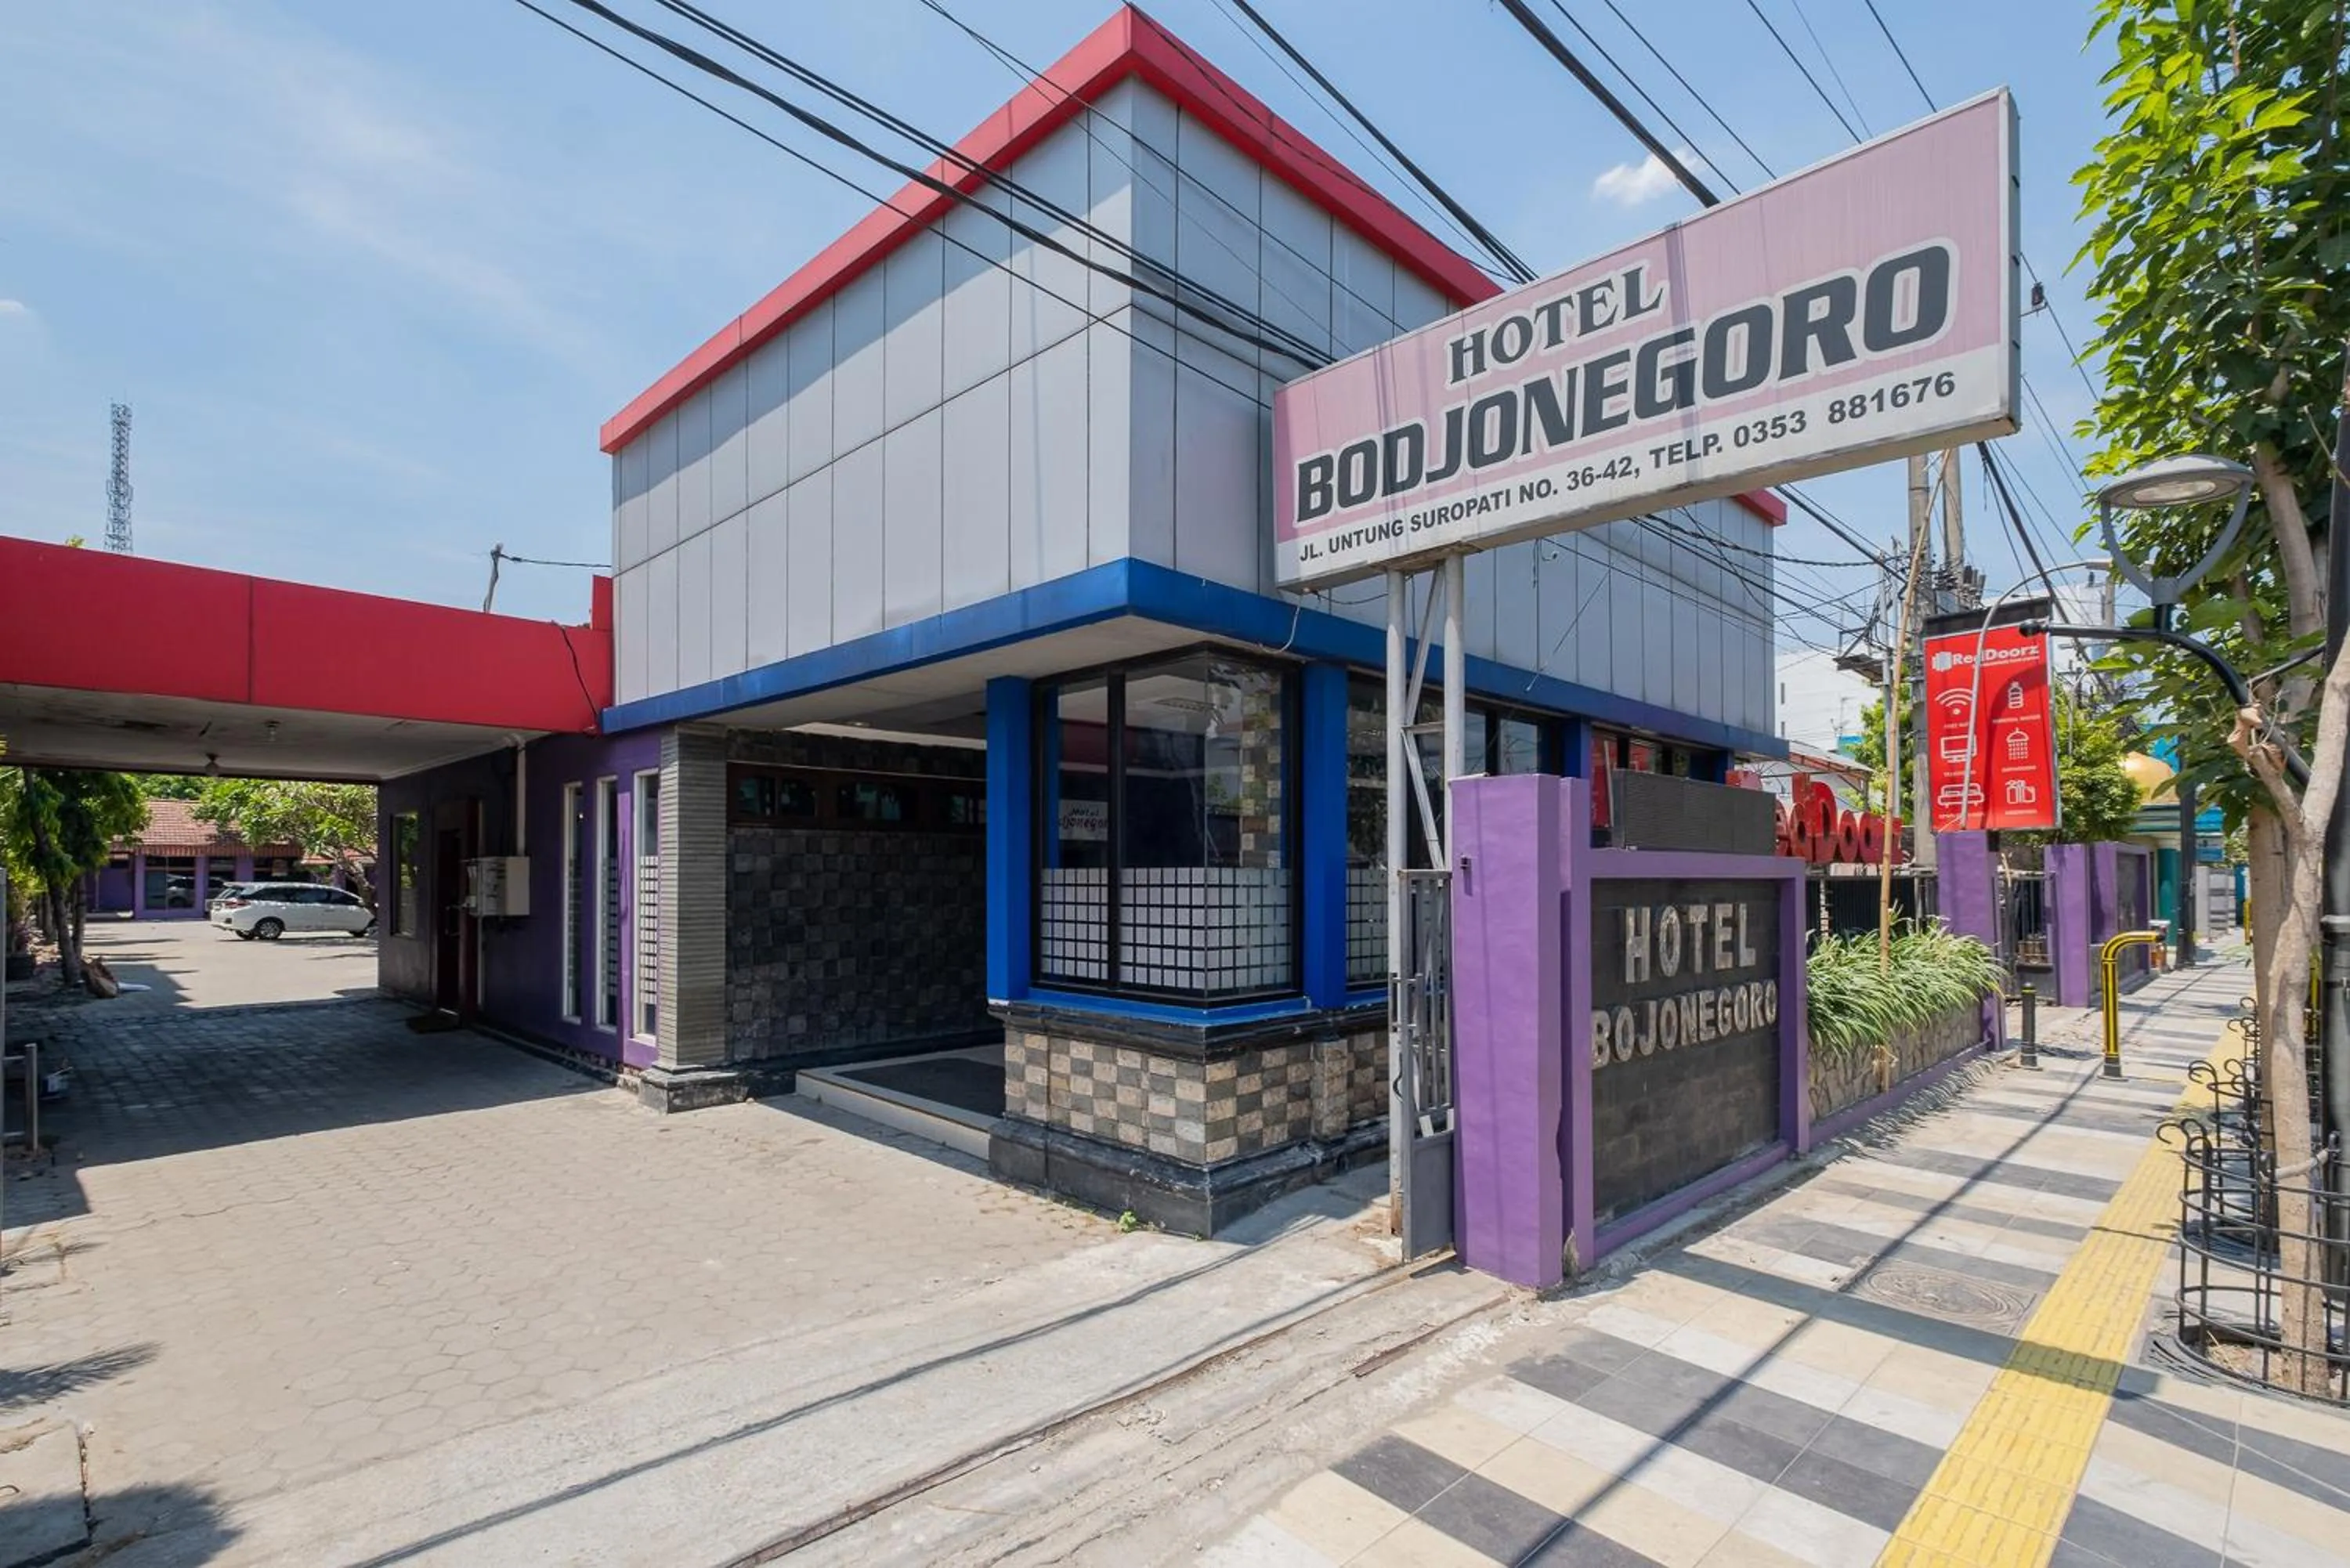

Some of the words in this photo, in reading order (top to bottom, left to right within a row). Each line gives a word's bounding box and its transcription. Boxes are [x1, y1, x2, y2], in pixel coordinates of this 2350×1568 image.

[1296, 245, 1950, 522] BODJONEGORO
[1449, 266, 1663, 384] HOTEL
[1300, 542, 1323, 562] JL.
[1329, 520, 1404, 555] UNTUNG
[1410, 488, 1510, 533] SUROPATI
[1518, 478, 1558, 504] NO.
[1566, 455, 1640, 491] 36-42,
[1649, 432, 1723, 469] TELP.
[1733, 410, 1807, 448] 0353
[1828, 370, 1955, 425] 881676
[1625, 902, 1756, 984] HOTEL
[1590, 979, 1777, 1071] BOJONEGORO
